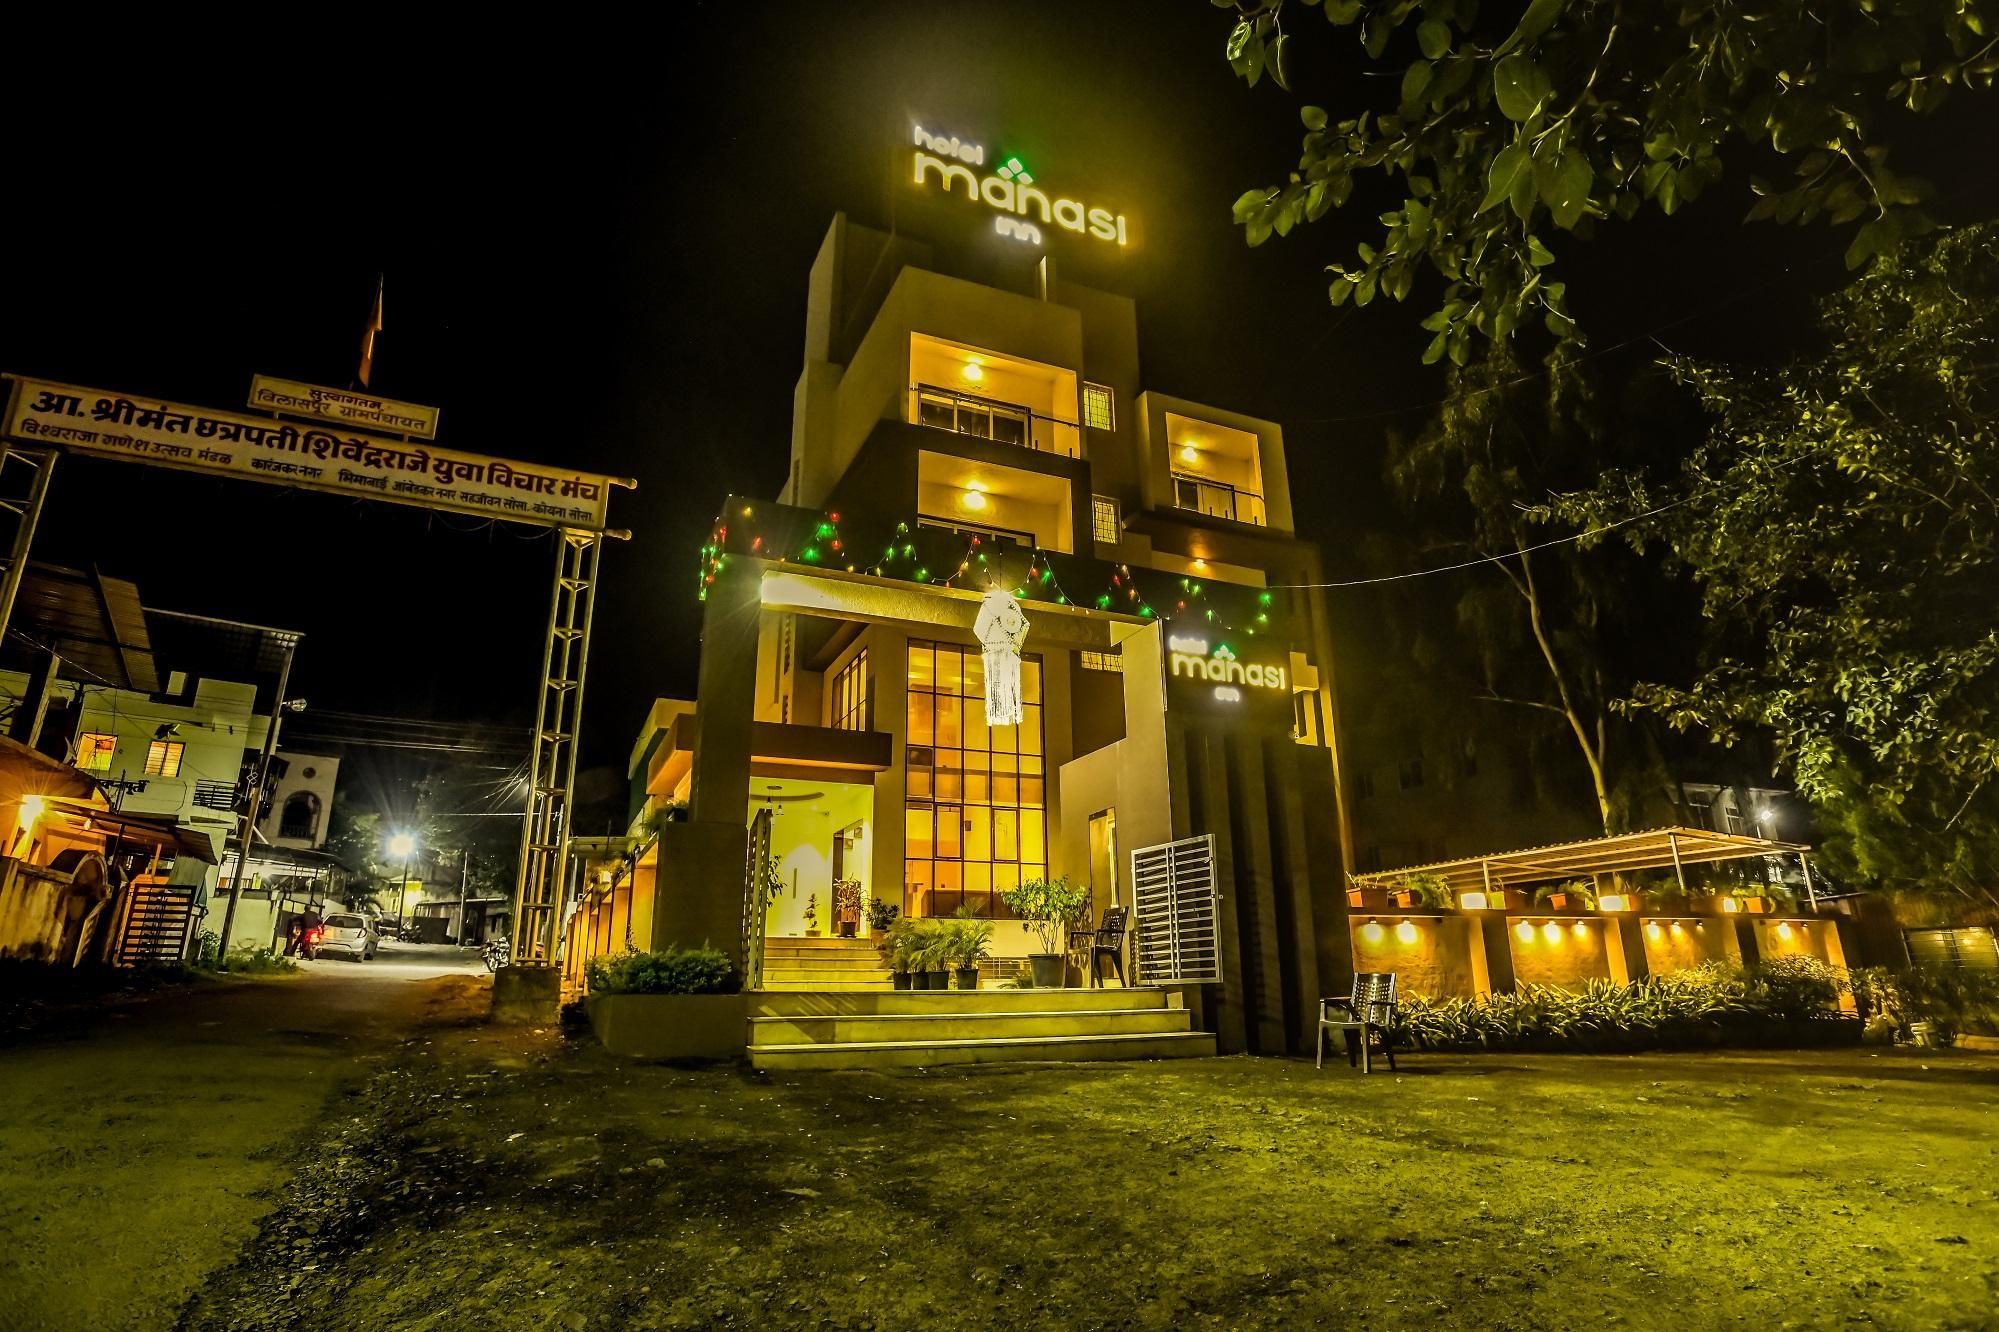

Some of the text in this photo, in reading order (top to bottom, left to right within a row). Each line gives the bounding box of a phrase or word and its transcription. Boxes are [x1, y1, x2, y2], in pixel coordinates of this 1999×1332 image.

[257, 388, 331, 415] विलासपूर
[21, 418, 99, 443] विश्वराजा
[102, 433, 150, 452] गणेश
[151, 442, 194, 458] उत्सव
[198, 448, 232, 465] मंडळ
[299, 465, 323, 479] नगर
[436, 488, 457, 501] नगर
[533, 501, 566, 519] कोयना
[30, 391, 601, 501] आ. श्रीमंत छत्रपती शिवेंद्रराजे युवा विचार मंच
[1171, 652, 1287, 690] manasi
